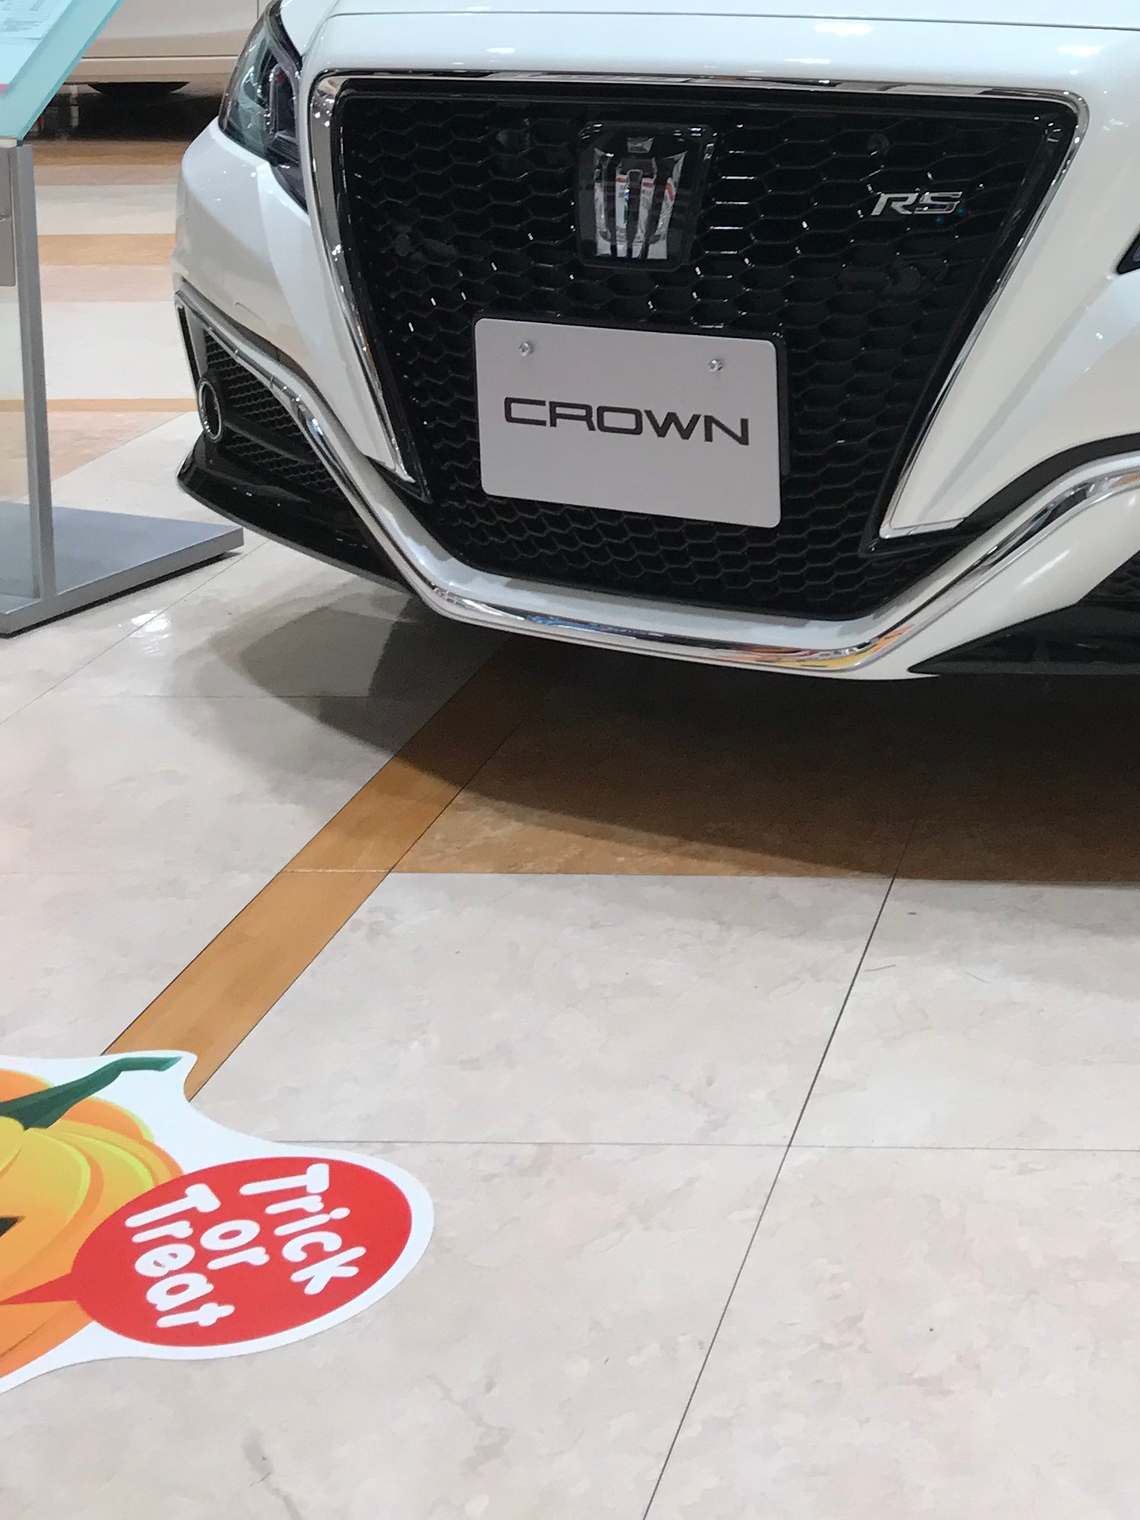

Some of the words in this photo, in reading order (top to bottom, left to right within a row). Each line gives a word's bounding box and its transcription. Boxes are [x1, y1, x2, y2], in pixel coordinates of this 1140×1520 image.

[870, 190, 964, 217] RS
[503, 396, 750, 447] CROWN
[200, 1219, 270, 1271] or
[239, 1163, 367, 1295] Trick
[125, 1183, 235, 1328] Treat
